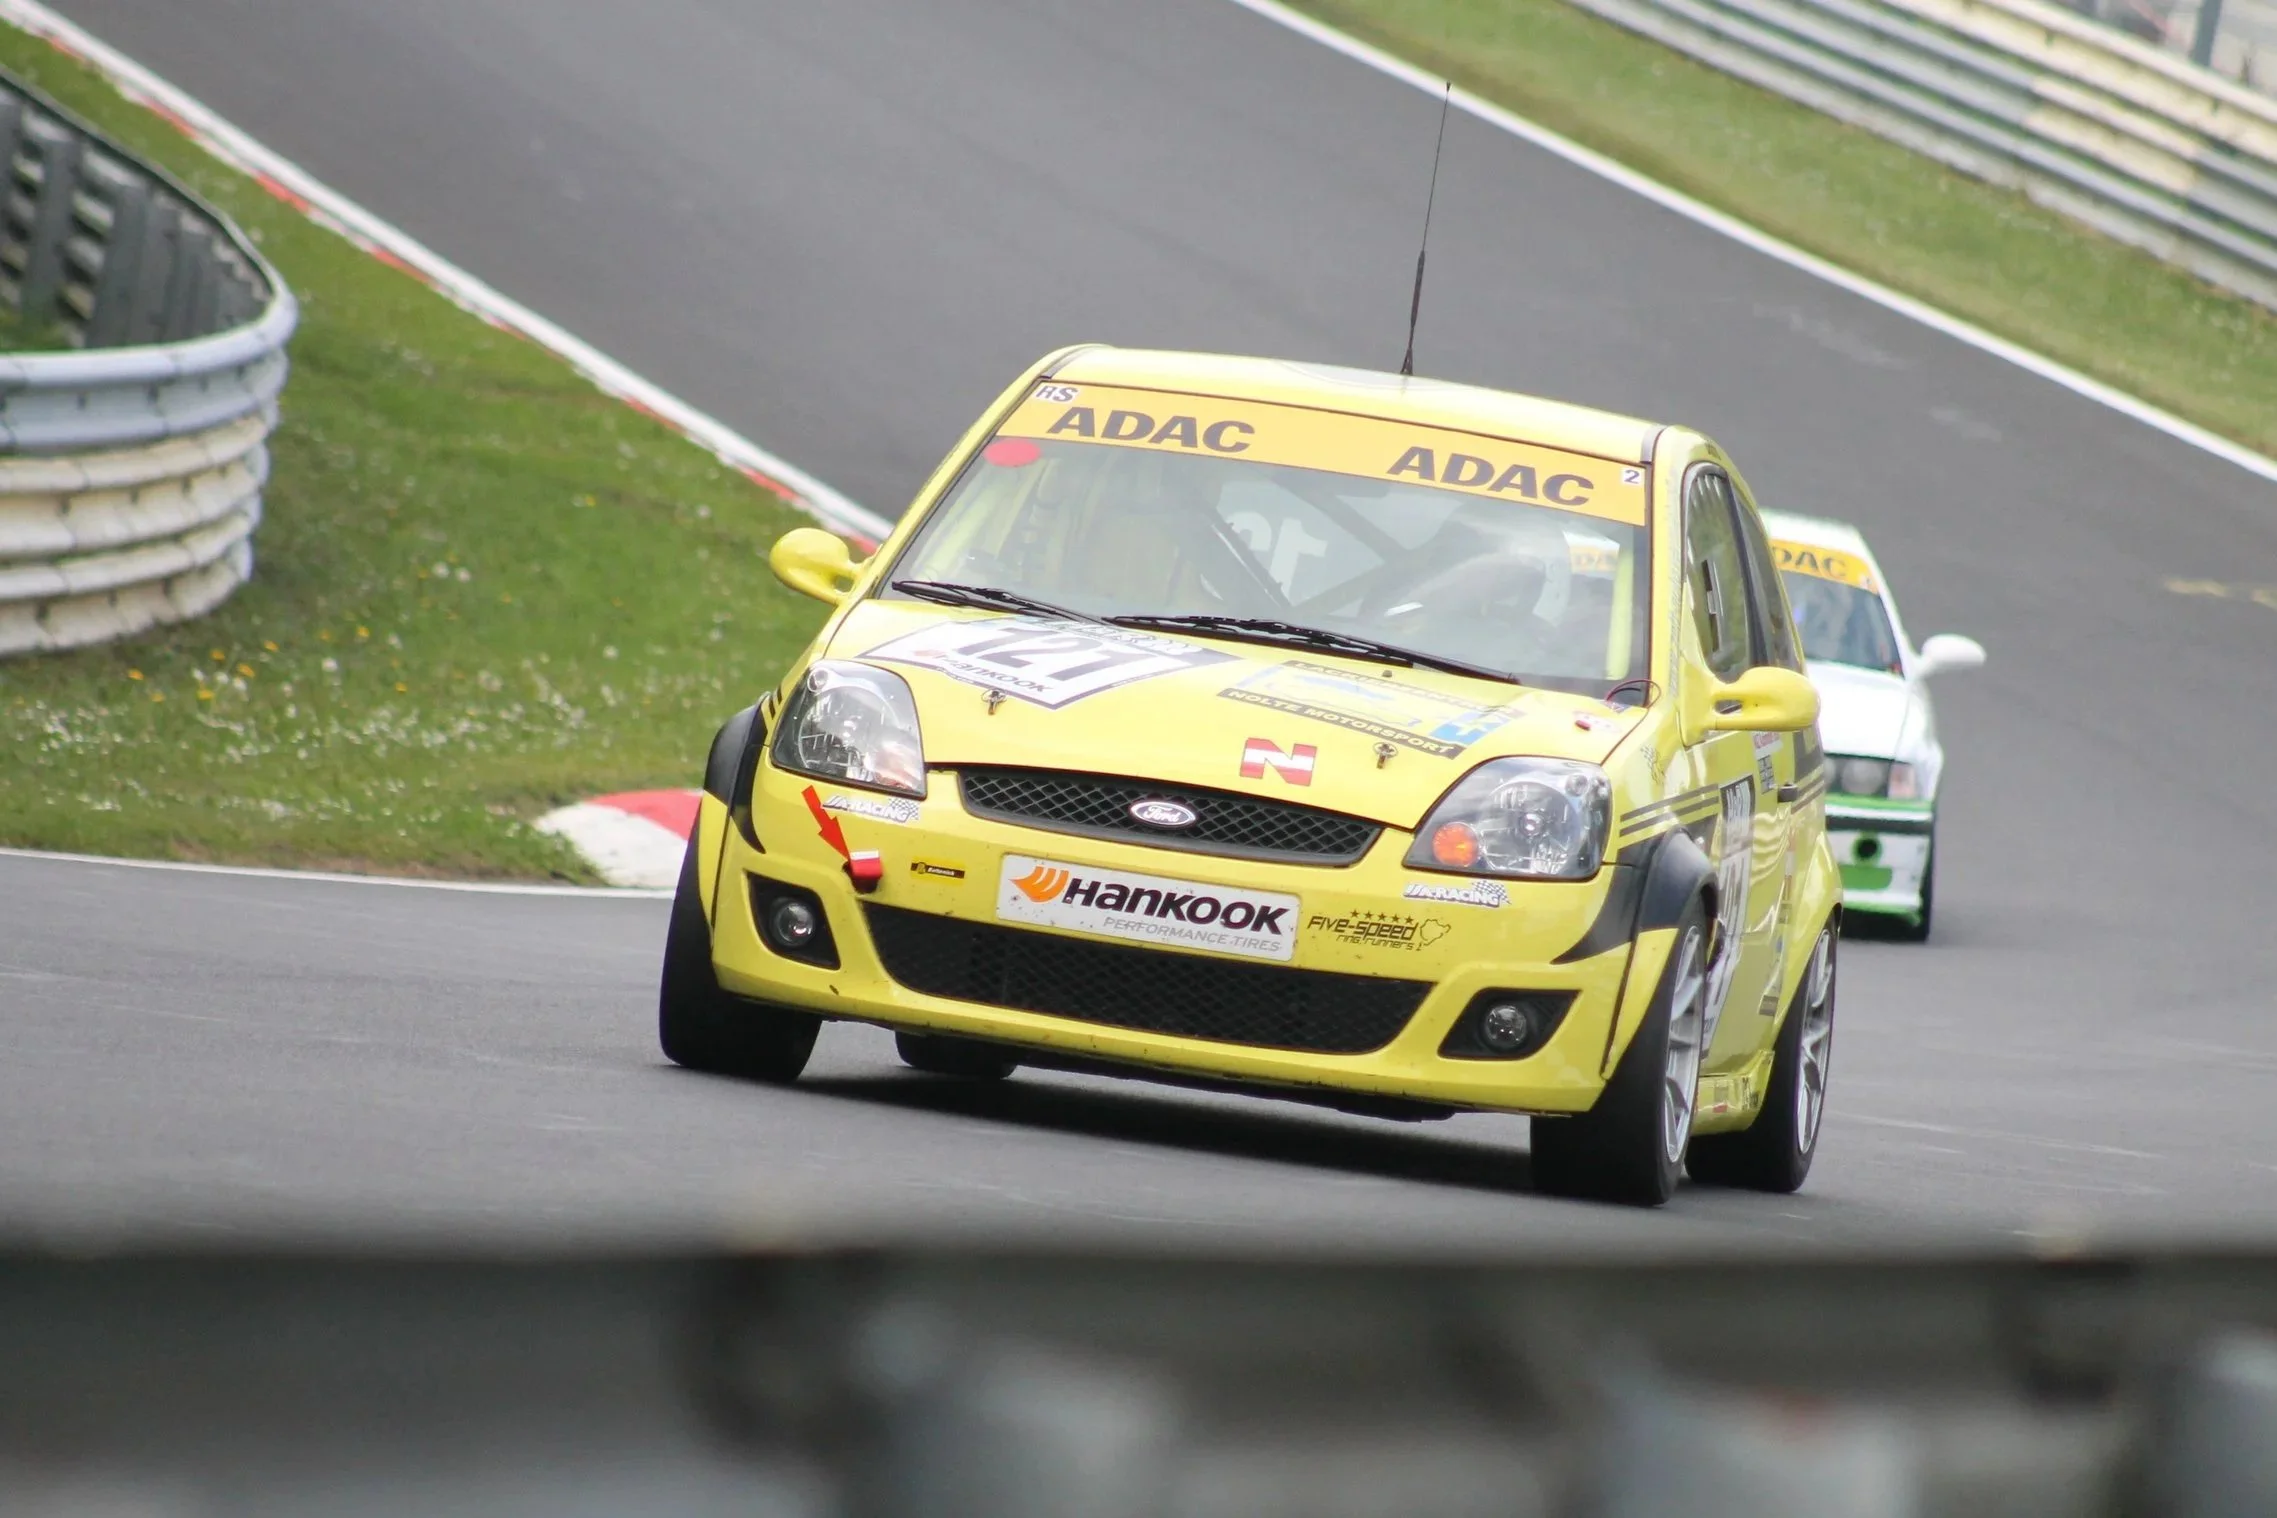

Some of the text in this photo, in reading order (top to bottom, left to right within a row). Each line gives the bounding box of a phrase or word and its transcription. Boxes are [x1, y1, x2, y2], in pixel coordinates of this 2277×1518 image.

[1036, 385, 1078, 402] RS
[1046, 406, 1256, 454] ADAC
[1386, 446, 1595, 506] ADAC
[1624, 469, 1640, 485] 2
[1227, 690, 1300, 713] NOLTE
[1304, 707, 1455, 756] MOTORSPORT
[1144, 806, 1181, 822] Ford
[1103, 917, 1283, 952] PERFORMANCE TIRES
